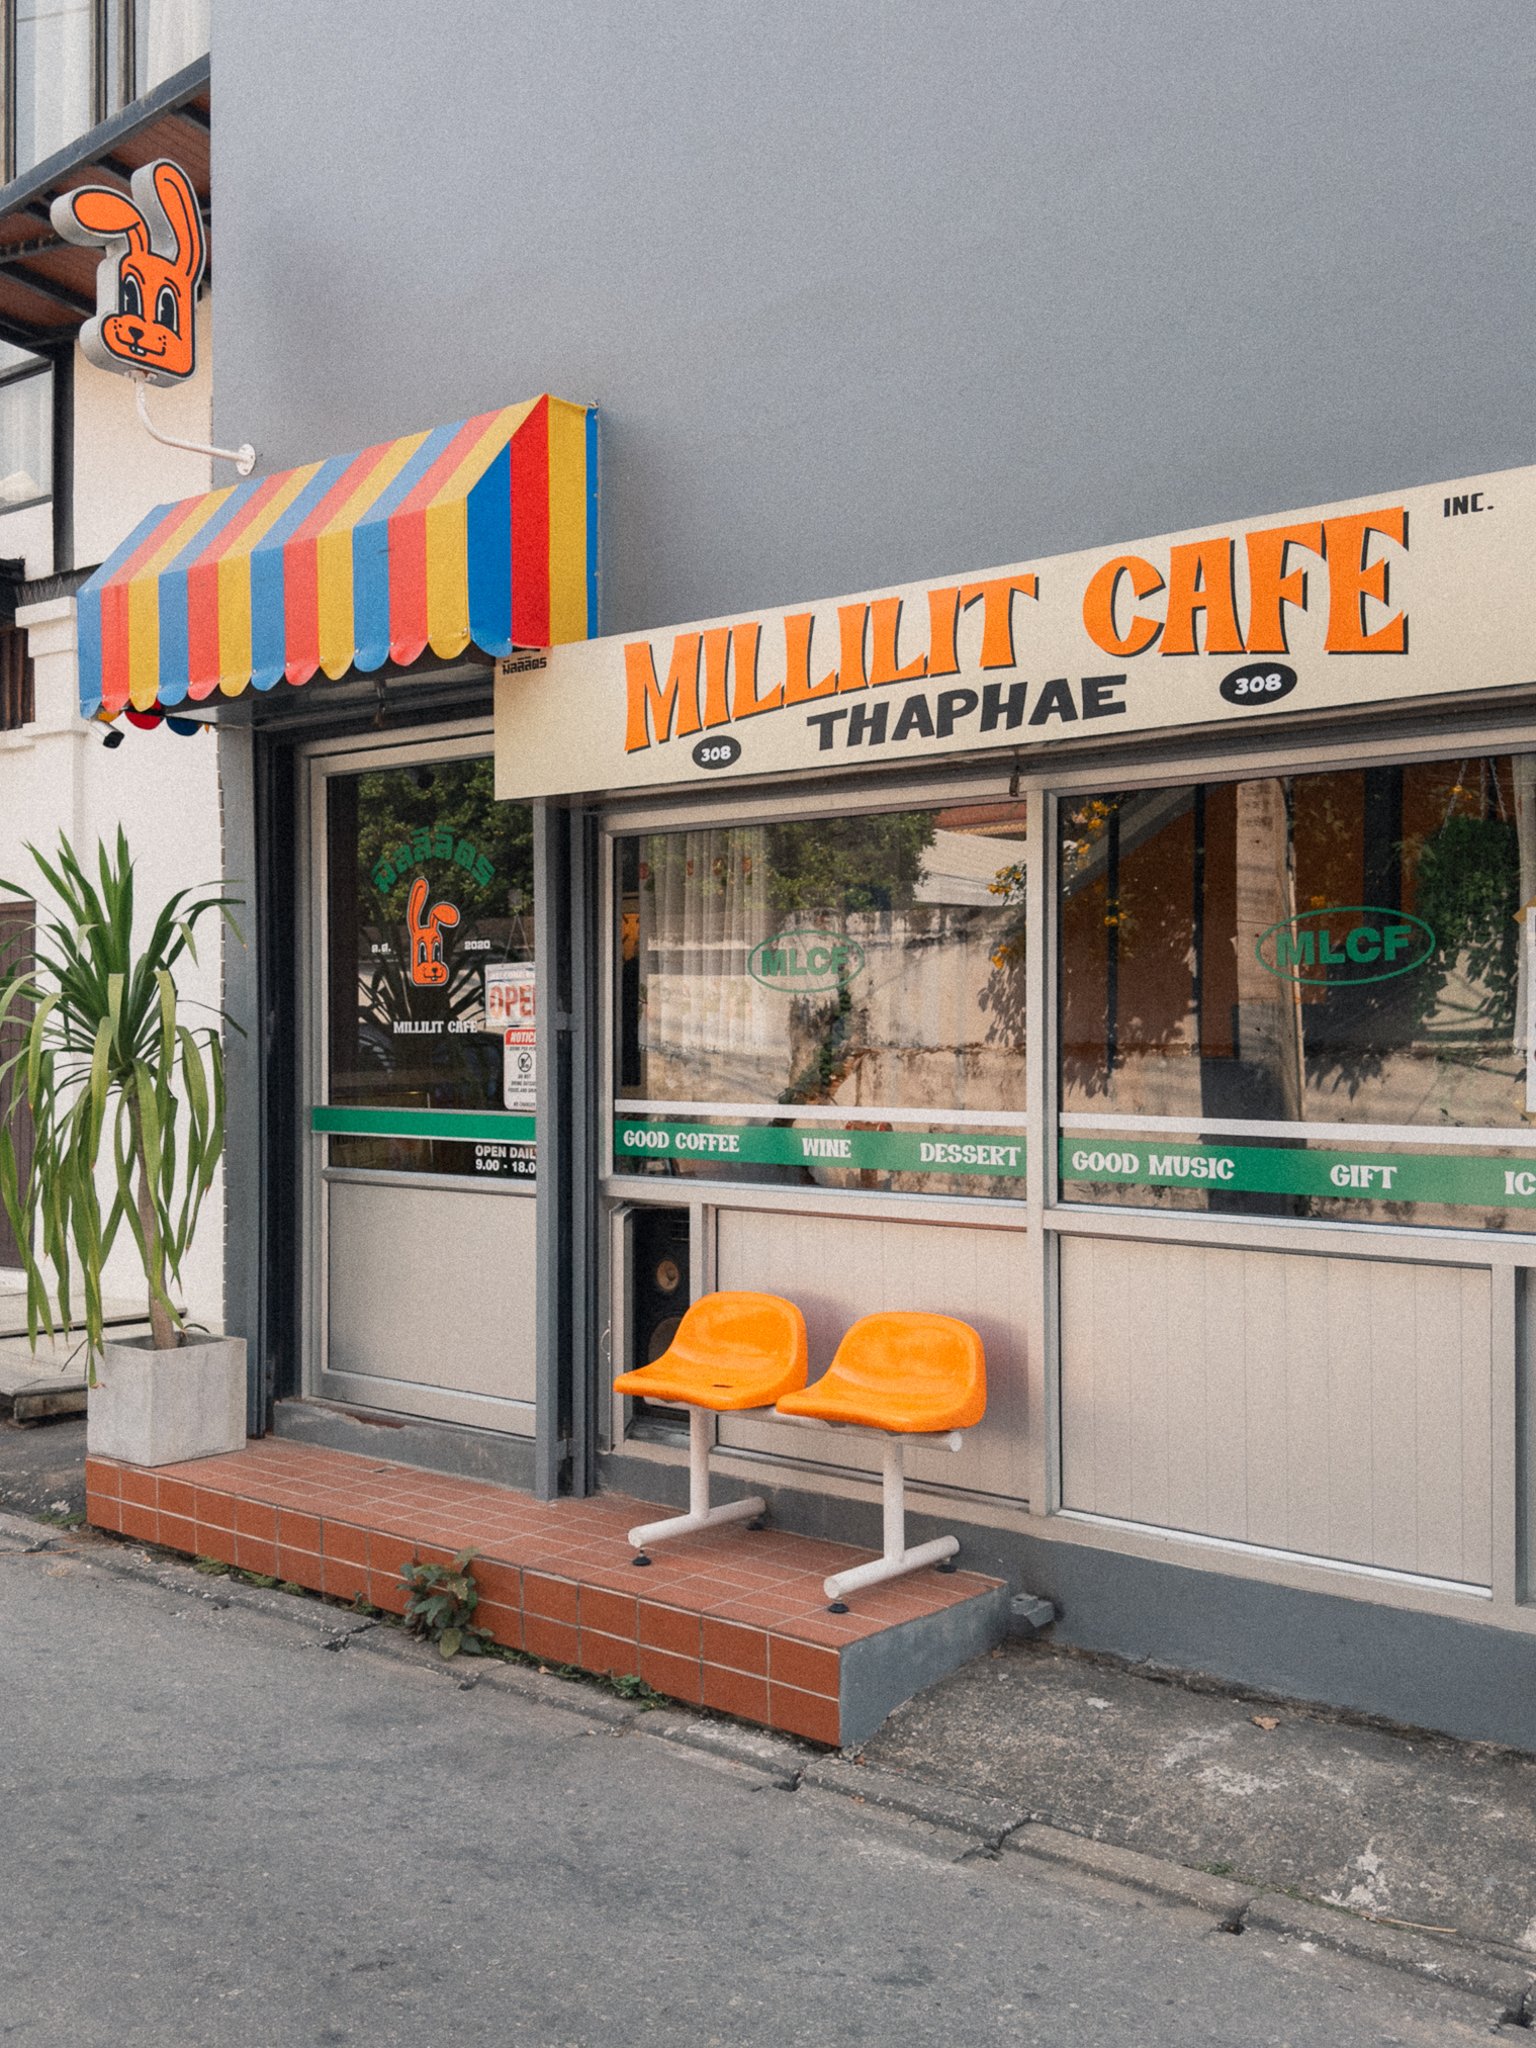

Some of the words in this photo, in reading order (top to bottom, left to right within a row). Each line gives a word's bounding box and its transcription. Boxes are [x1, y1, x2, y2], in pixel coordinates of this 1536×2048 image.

[1443, 492, 1495, 518] INC.
[624, 573, 1039, 754] MILLILIT
[1082, 506, 1409, 657] CAFE
[1235, 672, 1282, 695] 308
[806, 674, 1127, 751] THAPHAE
[701, 744, 731, 762] 308
[464, 940, 491, 950] 2020
[1275, 925, 1413, 967] MLCF
[760, 946, 850, 977] MLCF
[489, 984, 536, 1018] OPE
[393, 1021, 444, 1034] MILLILIT
[447, 1020, 478, 1034] CAFE
[510, 1031, 536, 1043] NOTIC
[475, 1144, 507, 1158] OPEN
[510, 1147, 536, 1160] DAIL
[623, 1129, 669, 1149] GOOD
[675, 1132, 740, 1153] COFFEE
[802, 1137, 852, 1158] WINE
[475, 1159, 500, 1171] 9.00
[920, 1142, 1021, 1167] DESSERT
[1072, 1150, 1139, 1174] GOOD
[1148, 1155, 1234, 1180] MUSIC
[1330, 1164, 1398, 1190] GIFT
